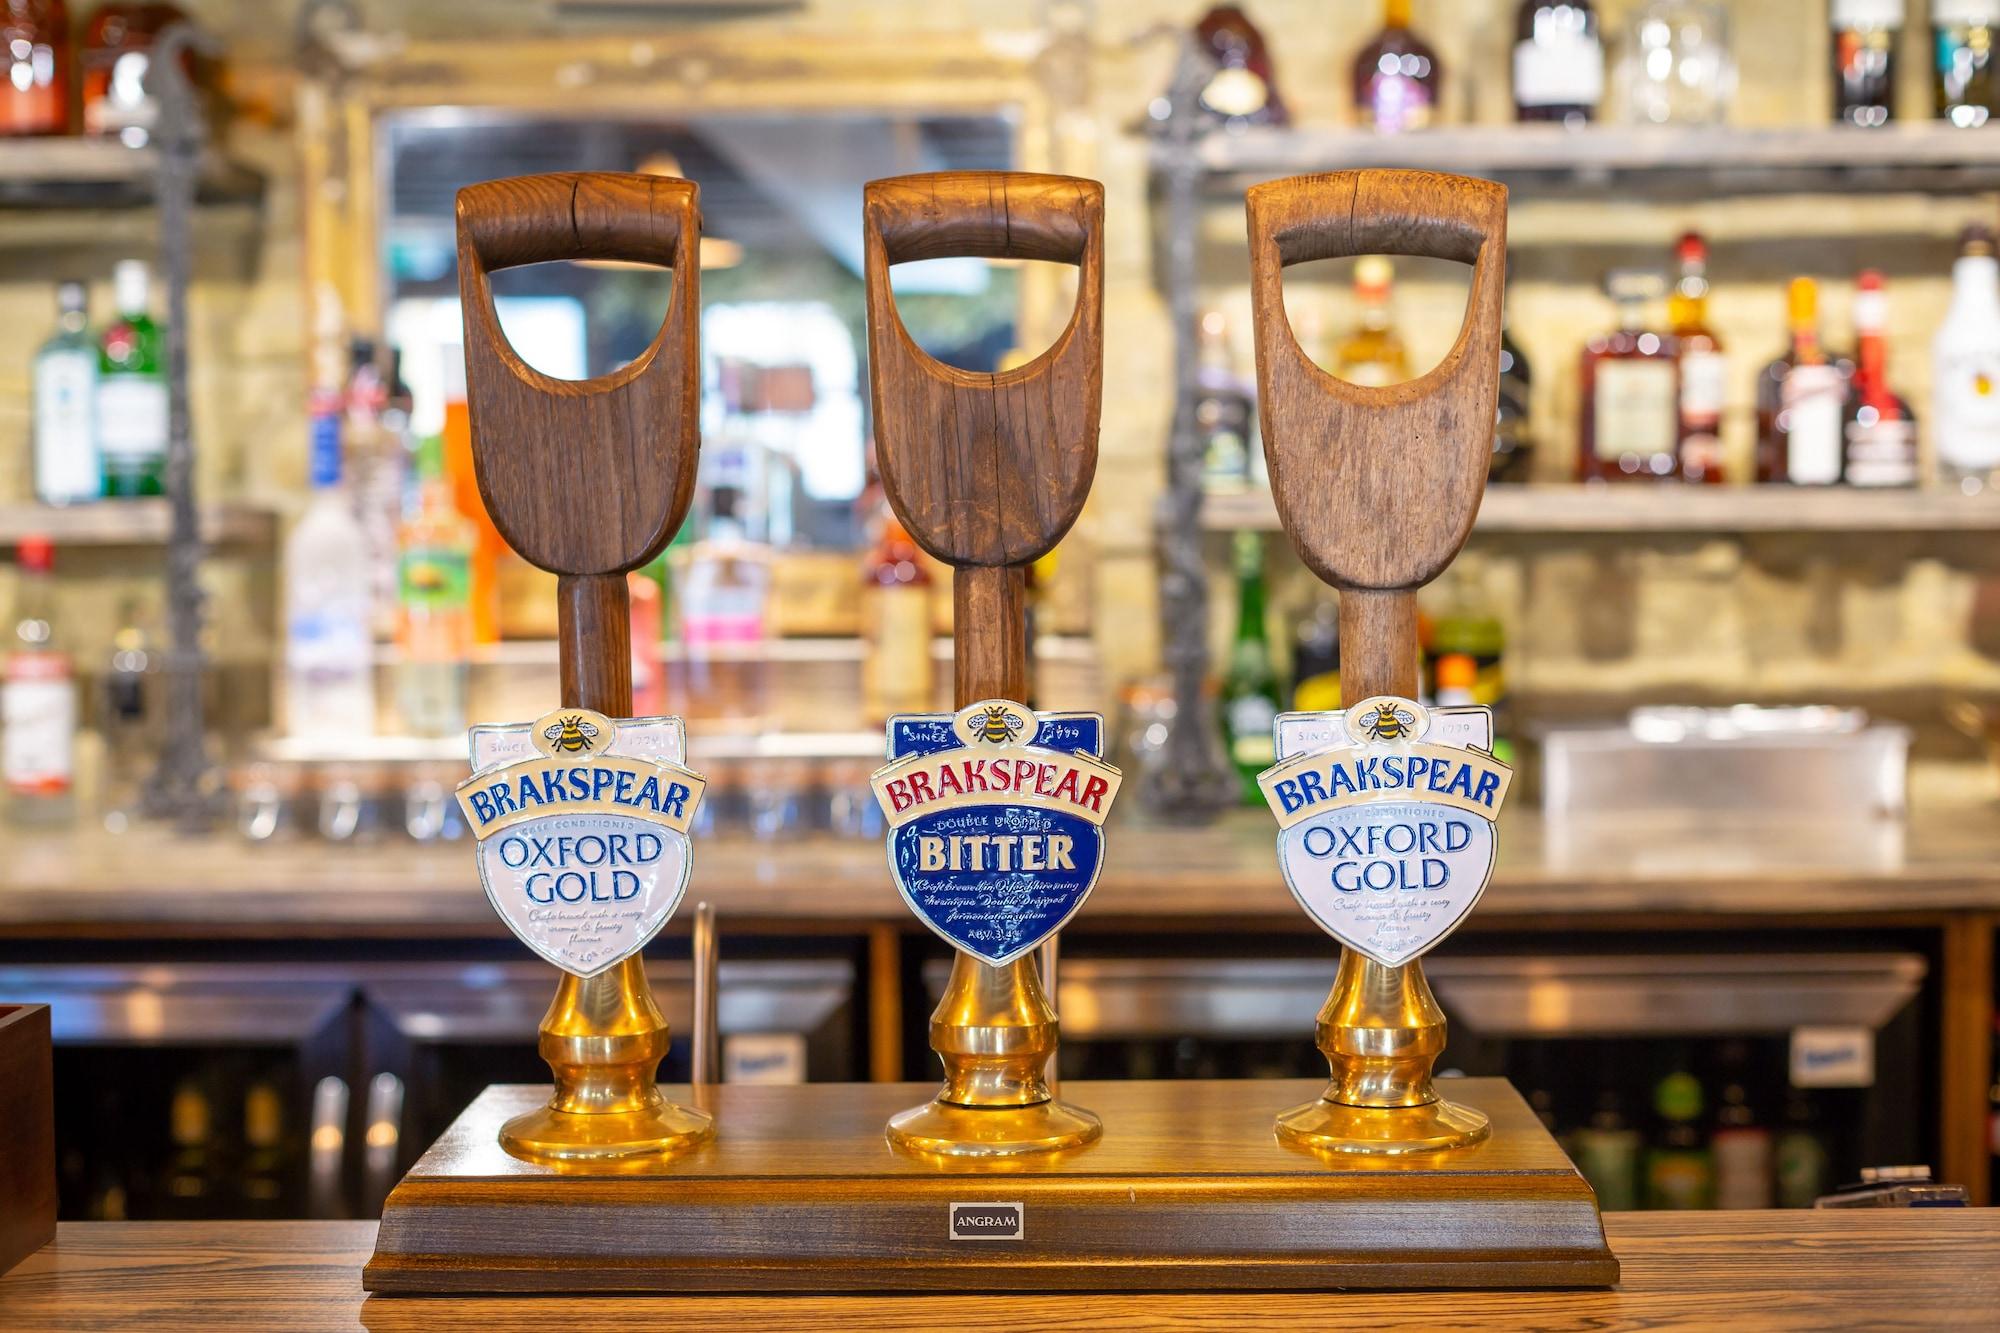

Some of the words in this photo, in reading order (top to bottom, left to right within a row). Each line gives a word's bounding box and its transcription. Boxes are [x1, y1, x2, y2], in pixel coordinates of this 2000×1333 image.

[908, 732, 947, 743] SINCE
[468, 767, 690, 826] BRAKSPEAR
[885, 759, 1109, 814] BRAKSPEAR
[1273, 756, 1501, 816] BRAKSPEAR
[936, 815, 989, 831] DOUBLE
[994, 815, 1052, 831] DROPPED
[1303, 820, 1473, 857] OXFORD
[499, 832, 663, 868] OXFORD
[918, 834, 1077, 872] BITTER
[525, 870, 641, 904] GOLD
[1331, 859, 1451, 893] GOLD
[946, 909, 1014, 923] fermentation
[956, 1216, 1017, 1227] ANGRAM
